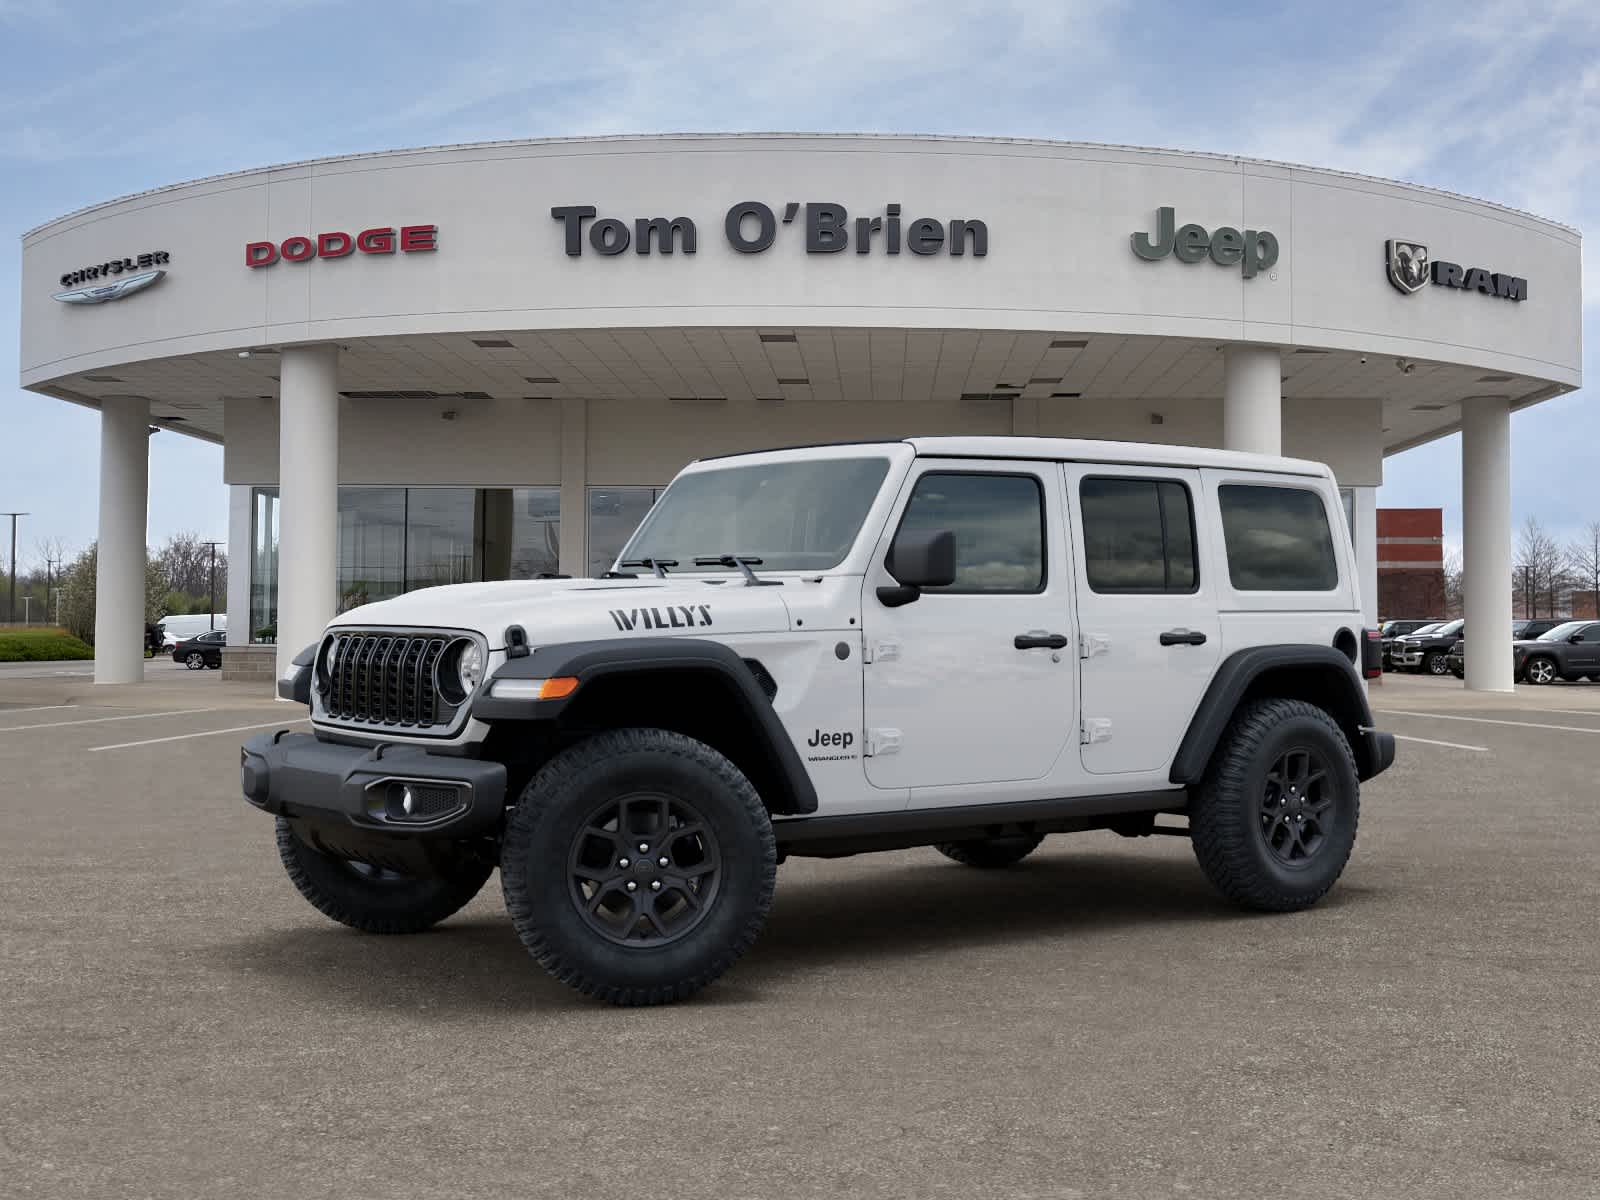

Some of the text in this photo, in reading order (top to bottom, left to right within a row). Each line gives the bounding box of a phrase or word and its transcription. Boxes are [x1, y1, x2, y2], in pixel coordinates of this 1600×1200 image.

[245, 225, 437, 268] DODGE
[551, 201, 988, 256] Tom O'Brien
[1131, 207, 1279, 278] Jeep
[60, 250, 169, 286] CHRYSLER
[1431, 261, 1528, 301] RAM
[608, 605, 712, 631] WILLYS
[808, 729, 853, 749] Jeep
